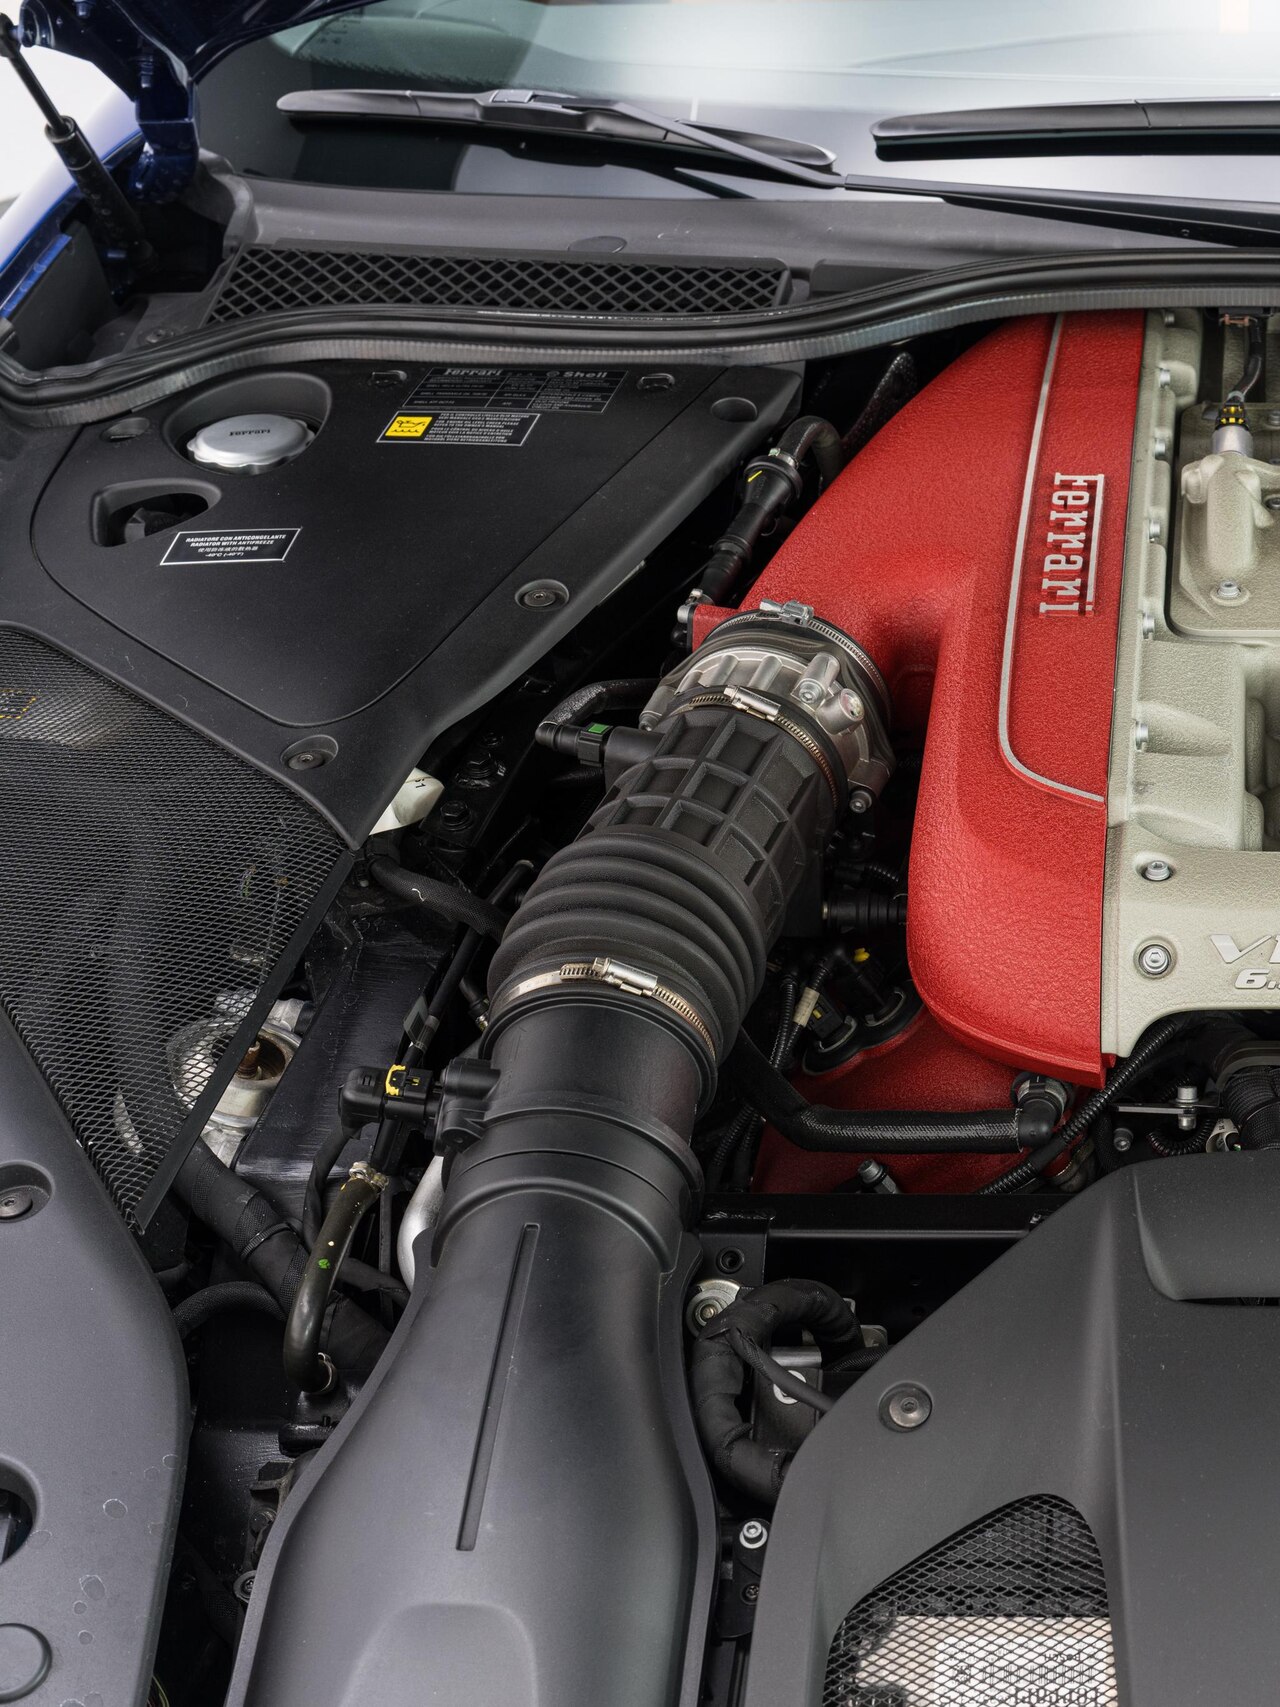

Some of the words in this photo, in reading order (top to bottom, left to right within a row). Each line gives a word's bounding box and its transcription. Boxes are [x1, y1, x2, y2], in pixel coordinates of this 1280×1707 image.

[444, 368, 503, 376] Ferrari
[229, 428, 270, 436] Ferrari
[1040, 472, 1104, 614] Ferrari
